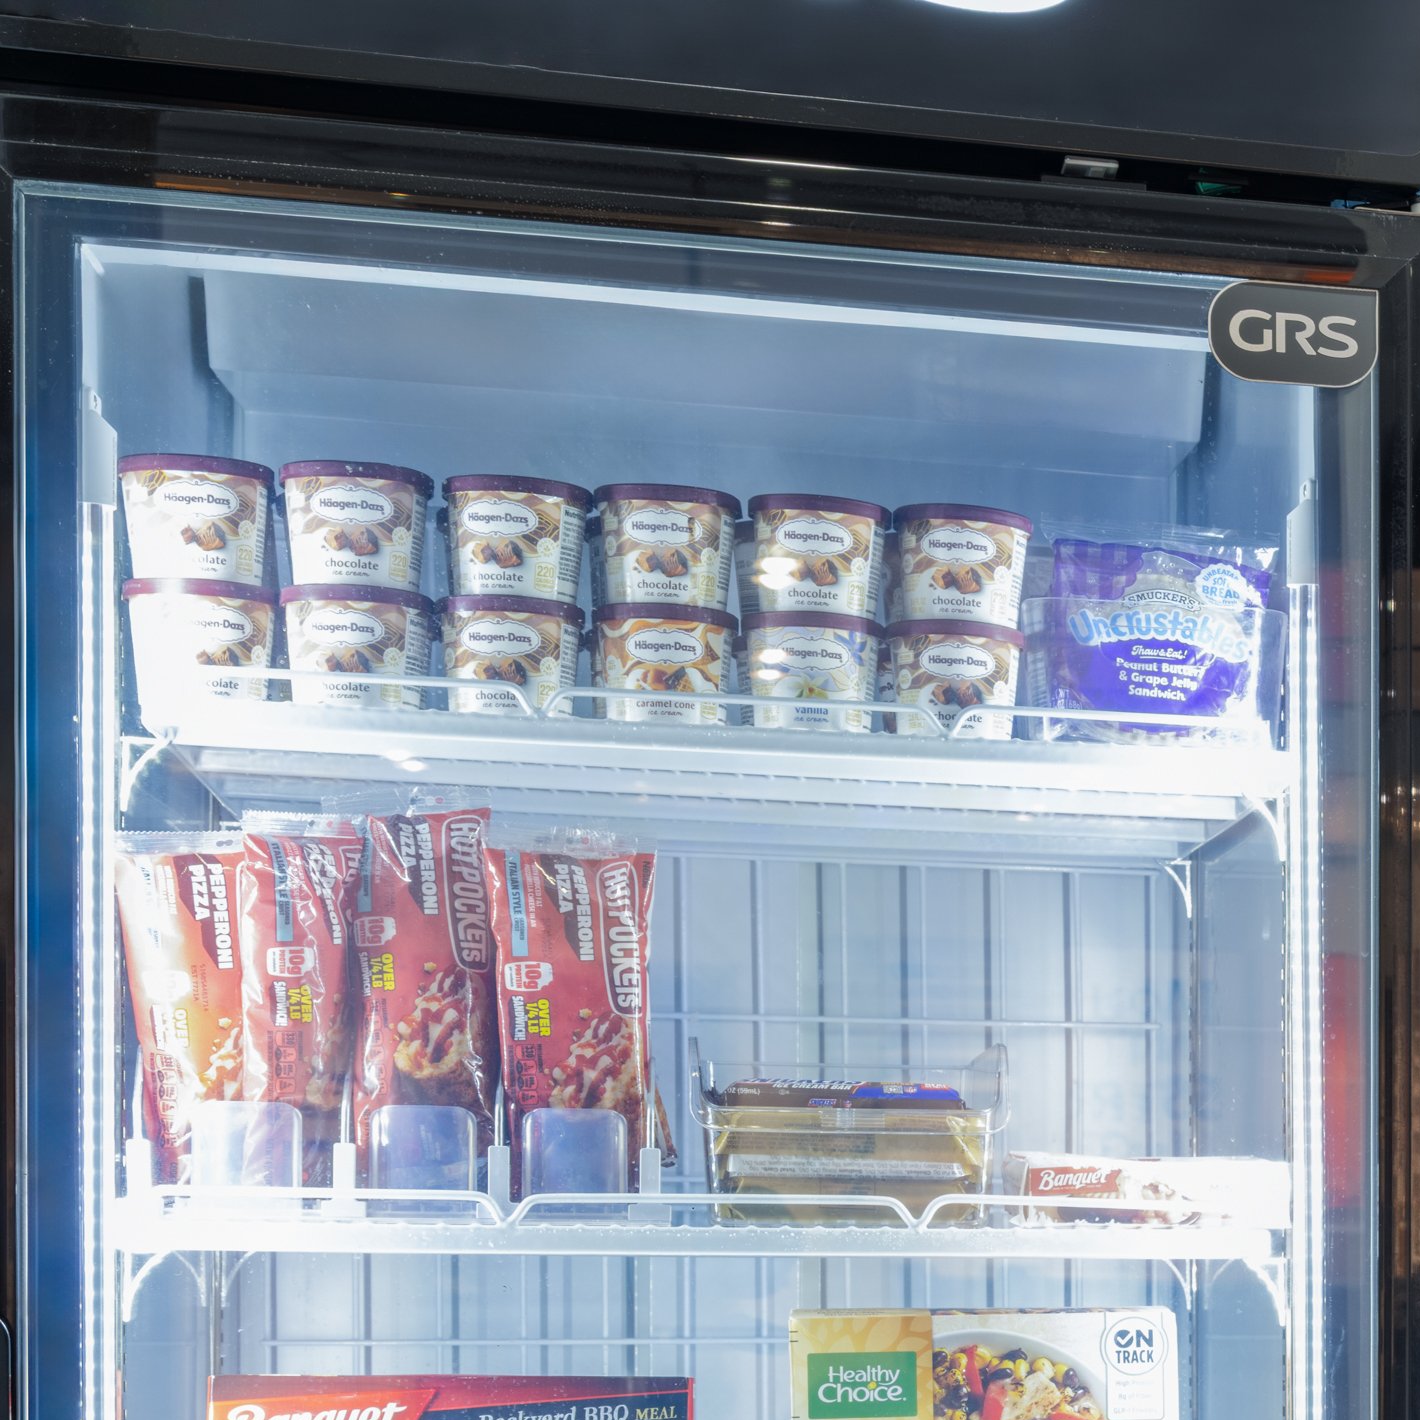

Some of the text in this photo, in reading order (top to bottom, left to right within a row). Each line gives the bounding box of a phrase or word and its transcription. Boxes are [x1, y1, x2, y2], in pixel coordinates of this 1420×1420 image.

[1228, 308, 1360, 359] GRS
[324, 557, 379, 571] chocolate
[637, 579, 689, 592] chocolate
[788, 587, 838, 600] chocolate
[932, 595, 982, 608] chocolate
[1068, 609, 1248, 659] Uncrustables
[1119, 671, 1197, 690] & Grape Jelly
[636, 699, 695, 710] caramel cone
[1128, 686, 1186, 701] Sandwich
[187, 863, 208, 921] PIZZA
[555, 863, 572, 914] PIZZA
[207, 863, 233, 969] PEPPERONI
[571, 864, 595, 961] PEPPERONI
[512, 995, 525, 1042] SANDWICH!
[538, 998, 550, 1037] OVER
[1038, 1168, 1107, 1191] Banquet
[1115, 1349, 1154, 1365] TRACK
[828, 1365, 899, 1386] Healthy
[817, 1381, 903, 1404] Choice
[636, 1406, 677, 1420] MEAL
